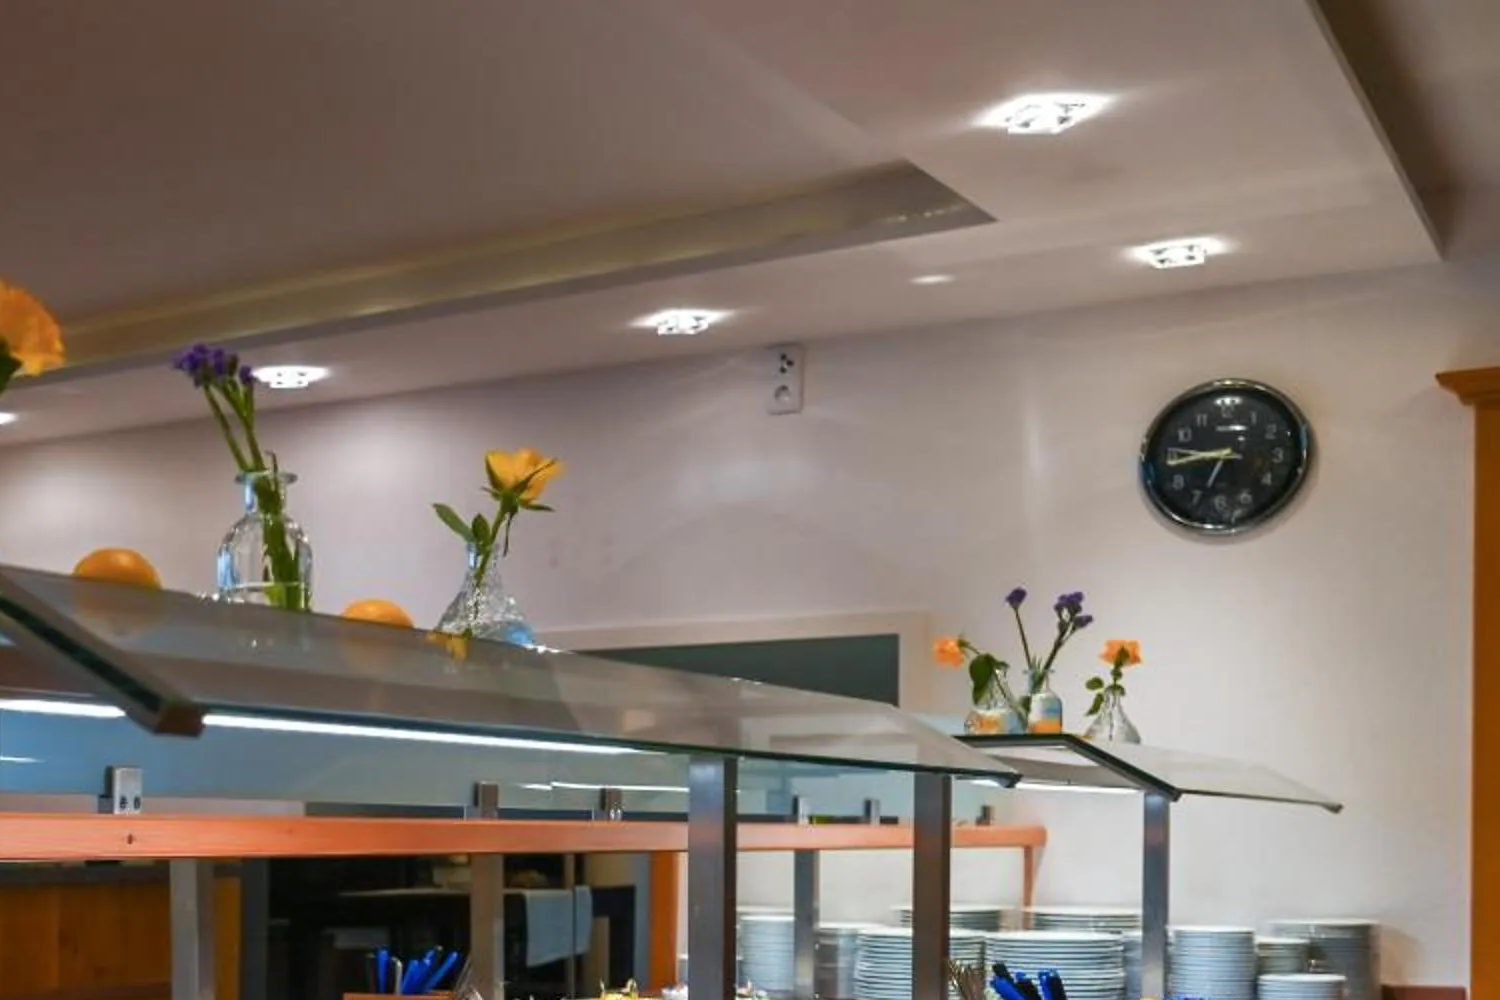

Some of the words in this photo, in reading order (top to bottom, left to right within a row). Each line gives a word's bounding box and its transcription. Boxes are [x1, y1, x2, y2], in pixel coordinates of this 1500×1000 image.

[1178, 428, 1192, 443] 10
[1265, 424, 1277, 440] 2
[1273, 447, 1284, 464] 3
[1173, 474, 1185, 490] 8
